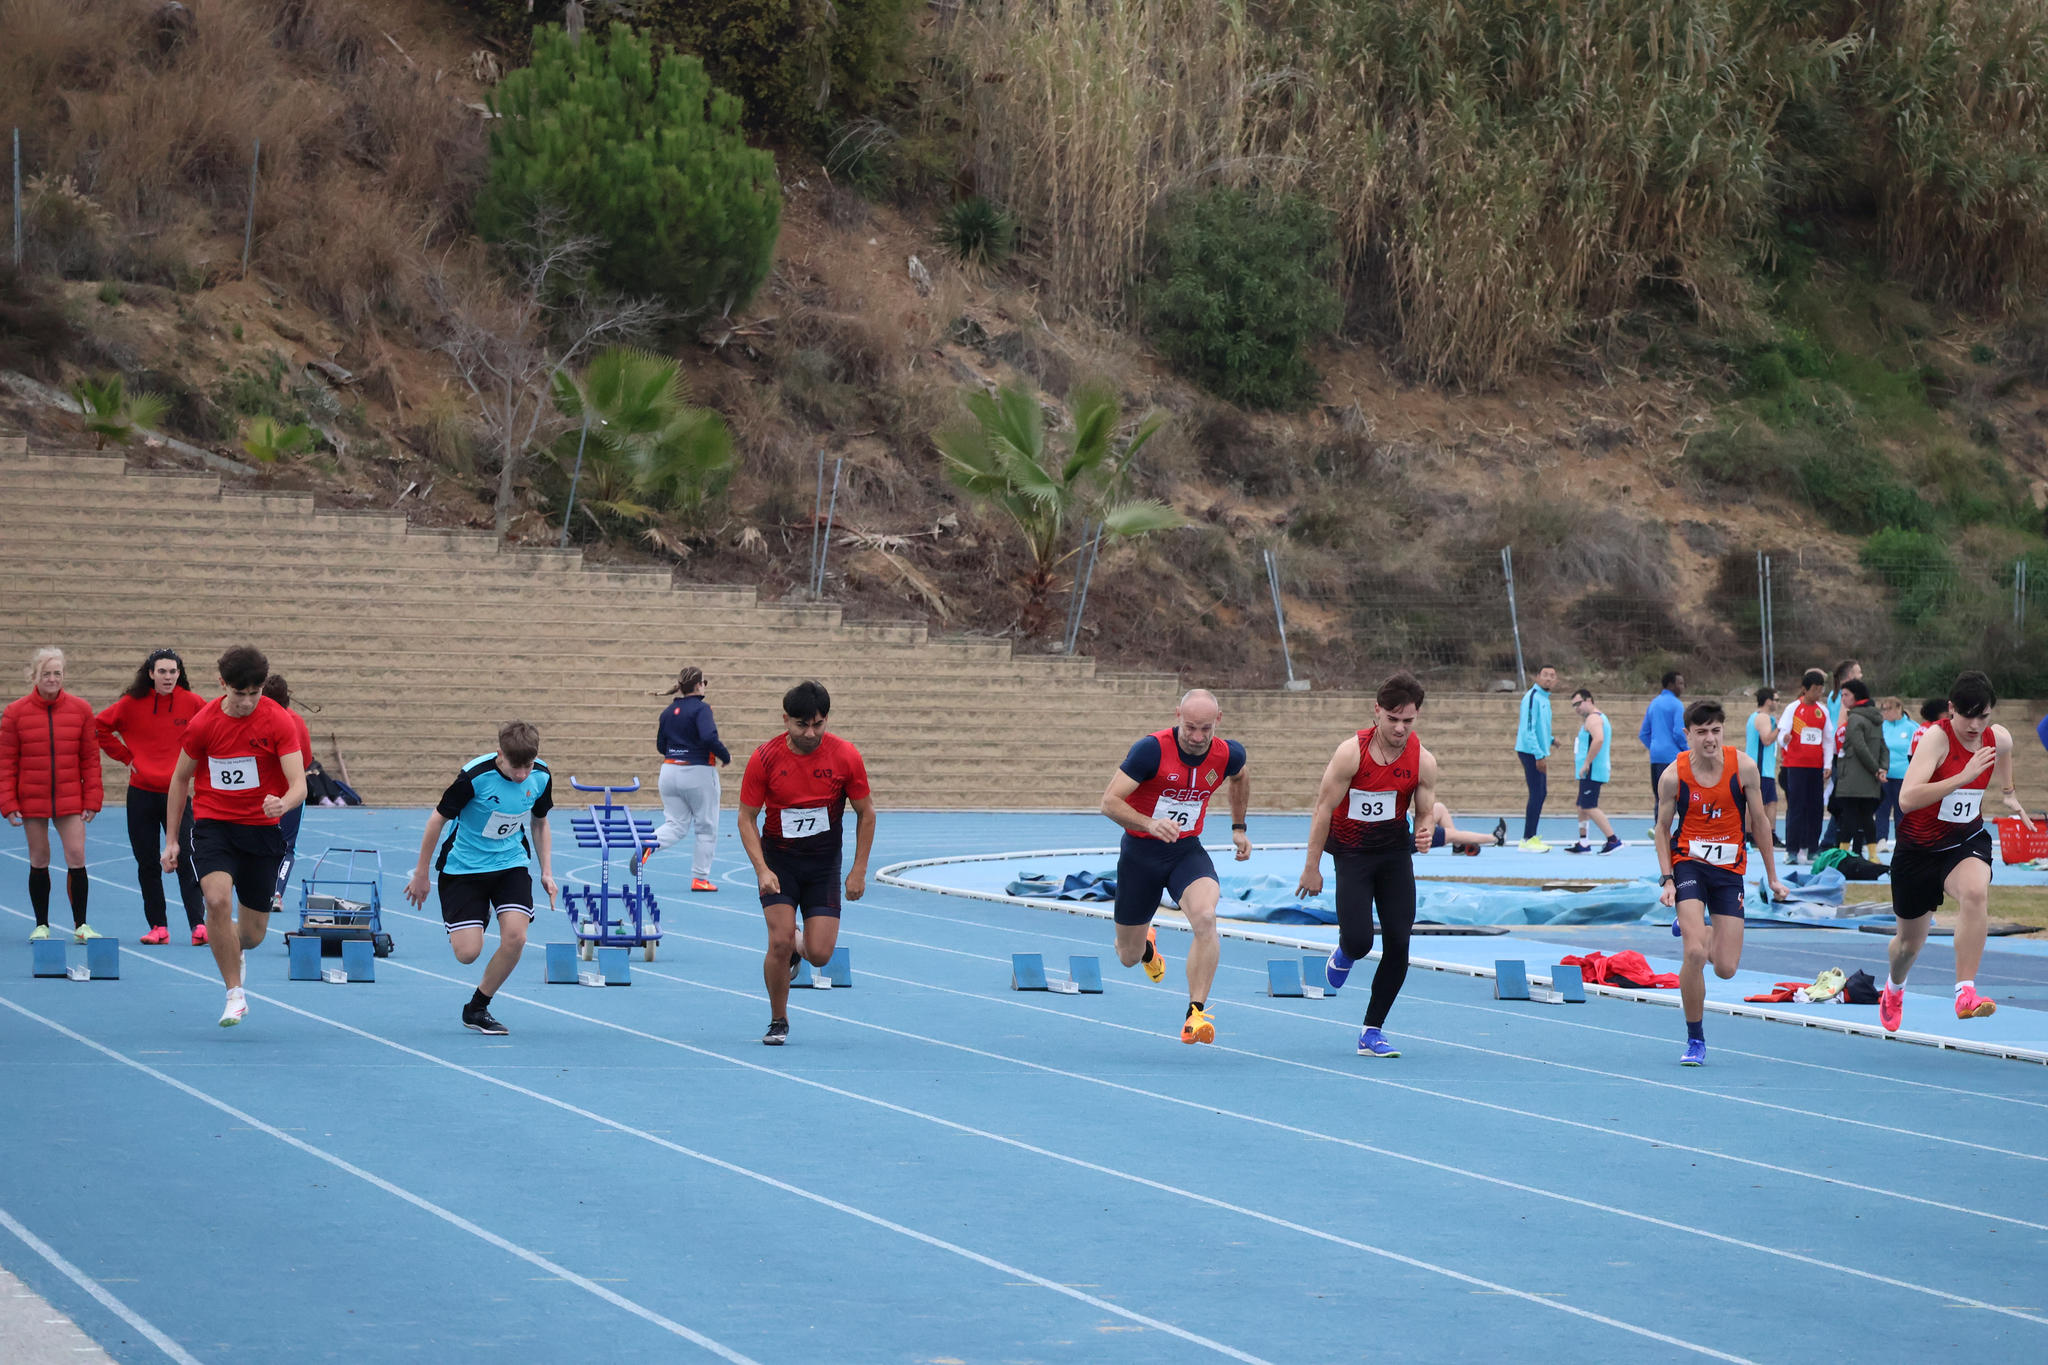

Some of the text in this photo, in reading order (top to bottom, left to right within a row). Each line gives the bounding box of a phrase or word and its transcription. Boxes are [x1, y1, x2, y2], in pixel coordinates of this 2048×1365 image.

[220, 770, 246, 785] 82
[1361, 802, 1384, 816] 93
[1952, 802, 1972, 817] 91
[793, 817, 816, 832] 77
[1167, 810, 1189, 827] 76
[497, 822, 519, 836] 67
[1701, 844, 1723, 860] 71
